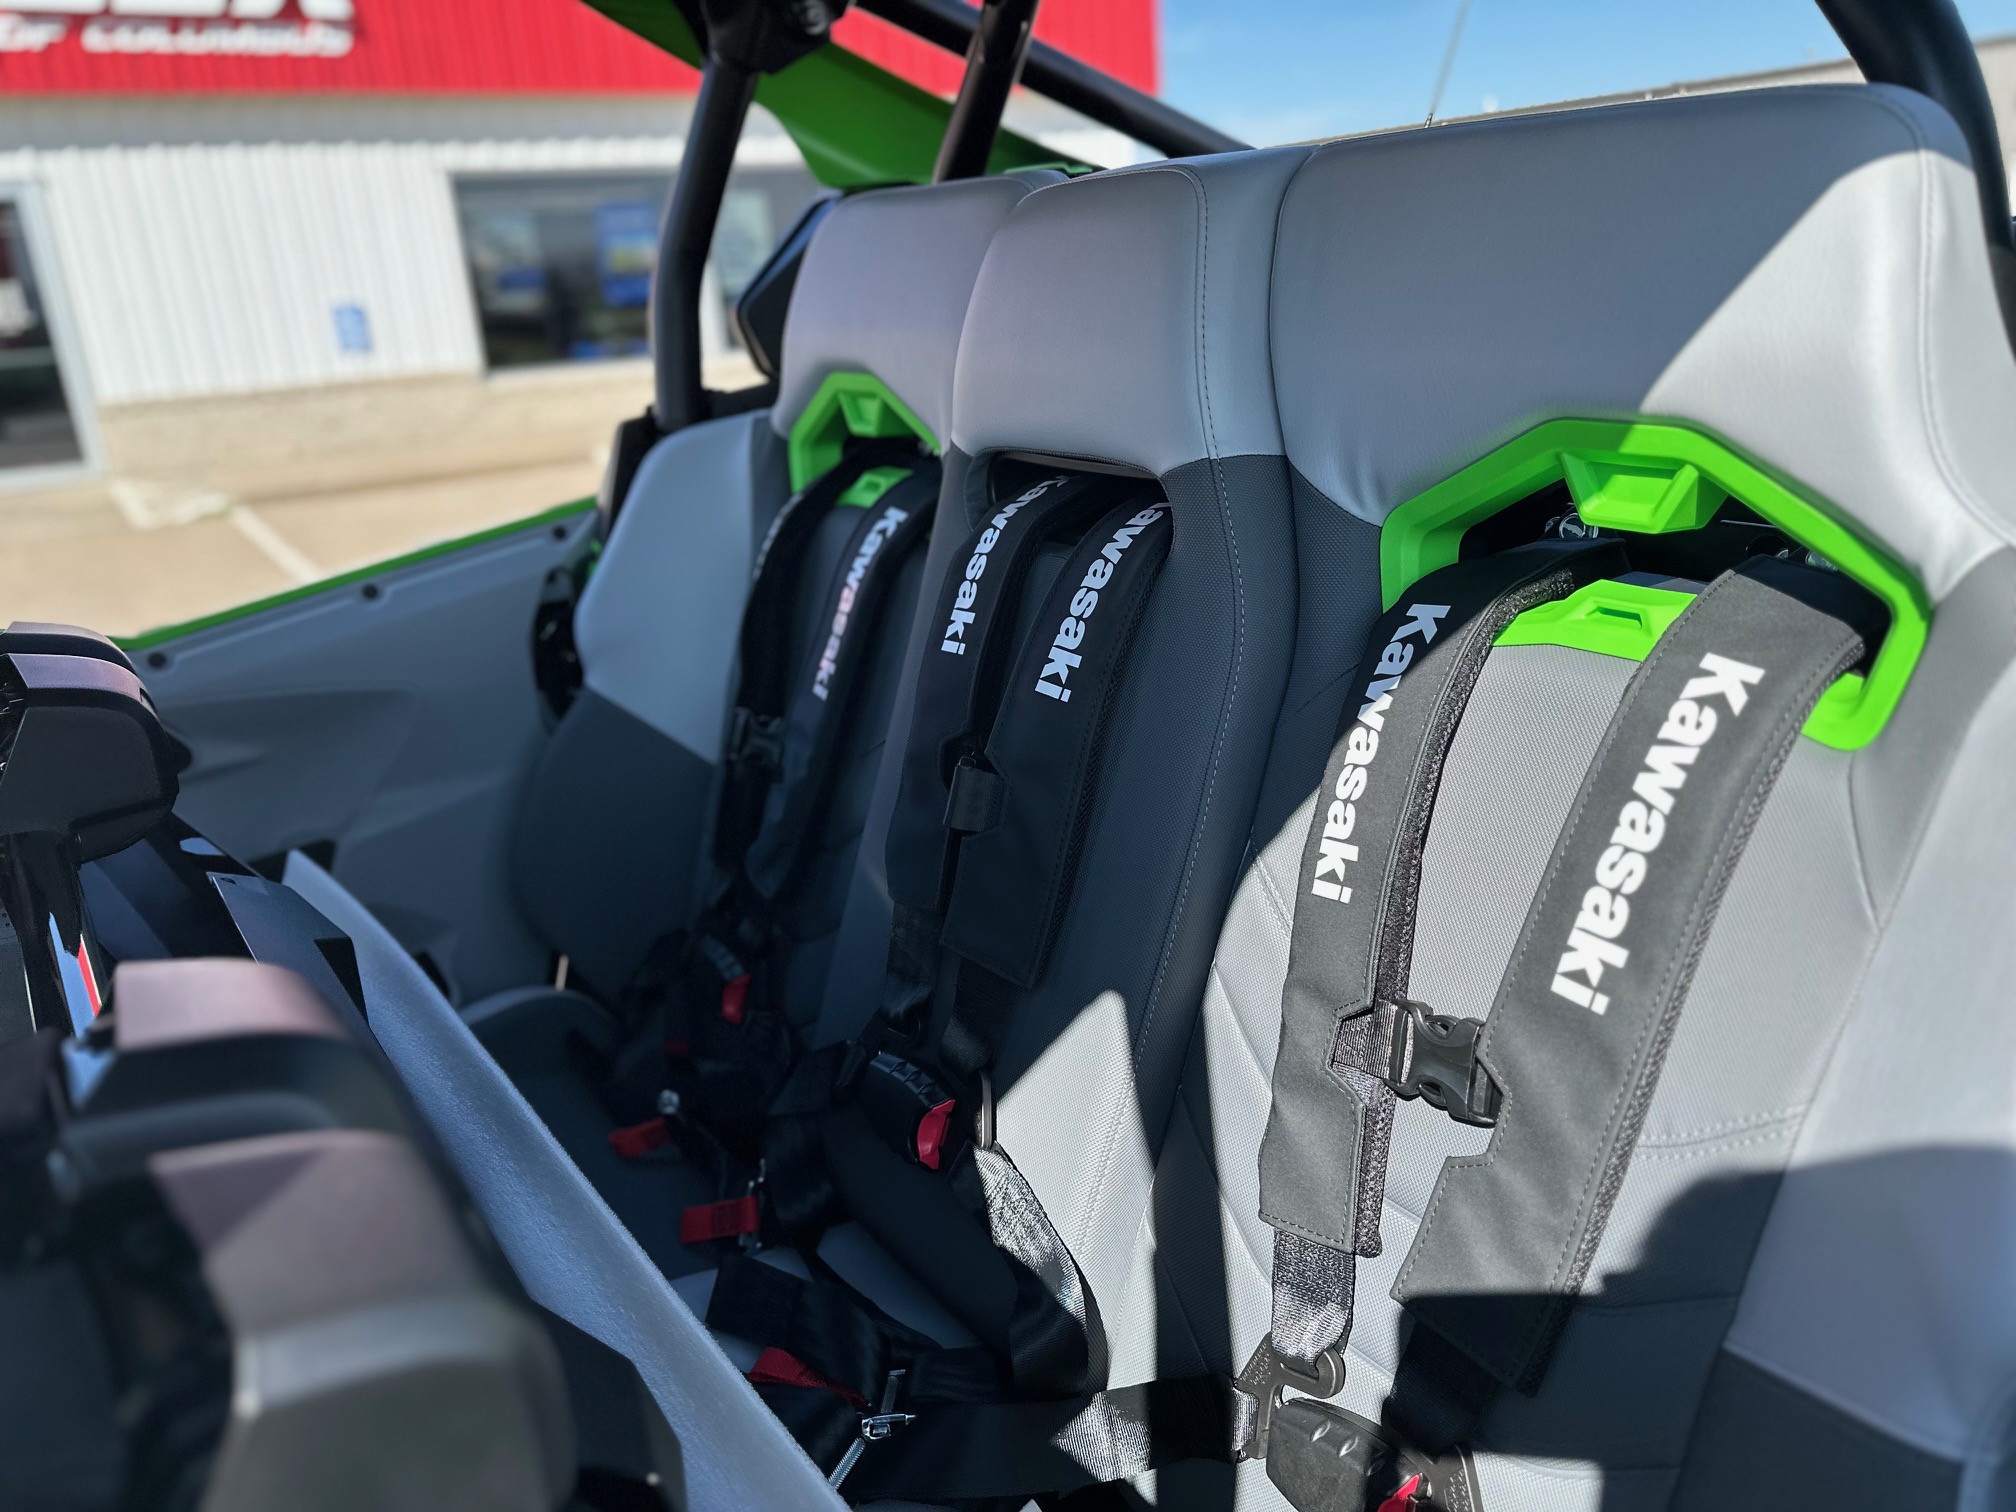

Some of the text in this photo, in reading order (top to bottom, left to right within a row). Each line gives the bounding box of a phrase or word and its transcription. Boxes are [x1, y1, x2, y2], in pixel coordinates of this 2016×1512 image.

[811, 506, 909, 701] Kawasaki
[1311, 603, 1451, 904] Kawasaki
[1550, 652, 1766, 1016] Kawasaki
